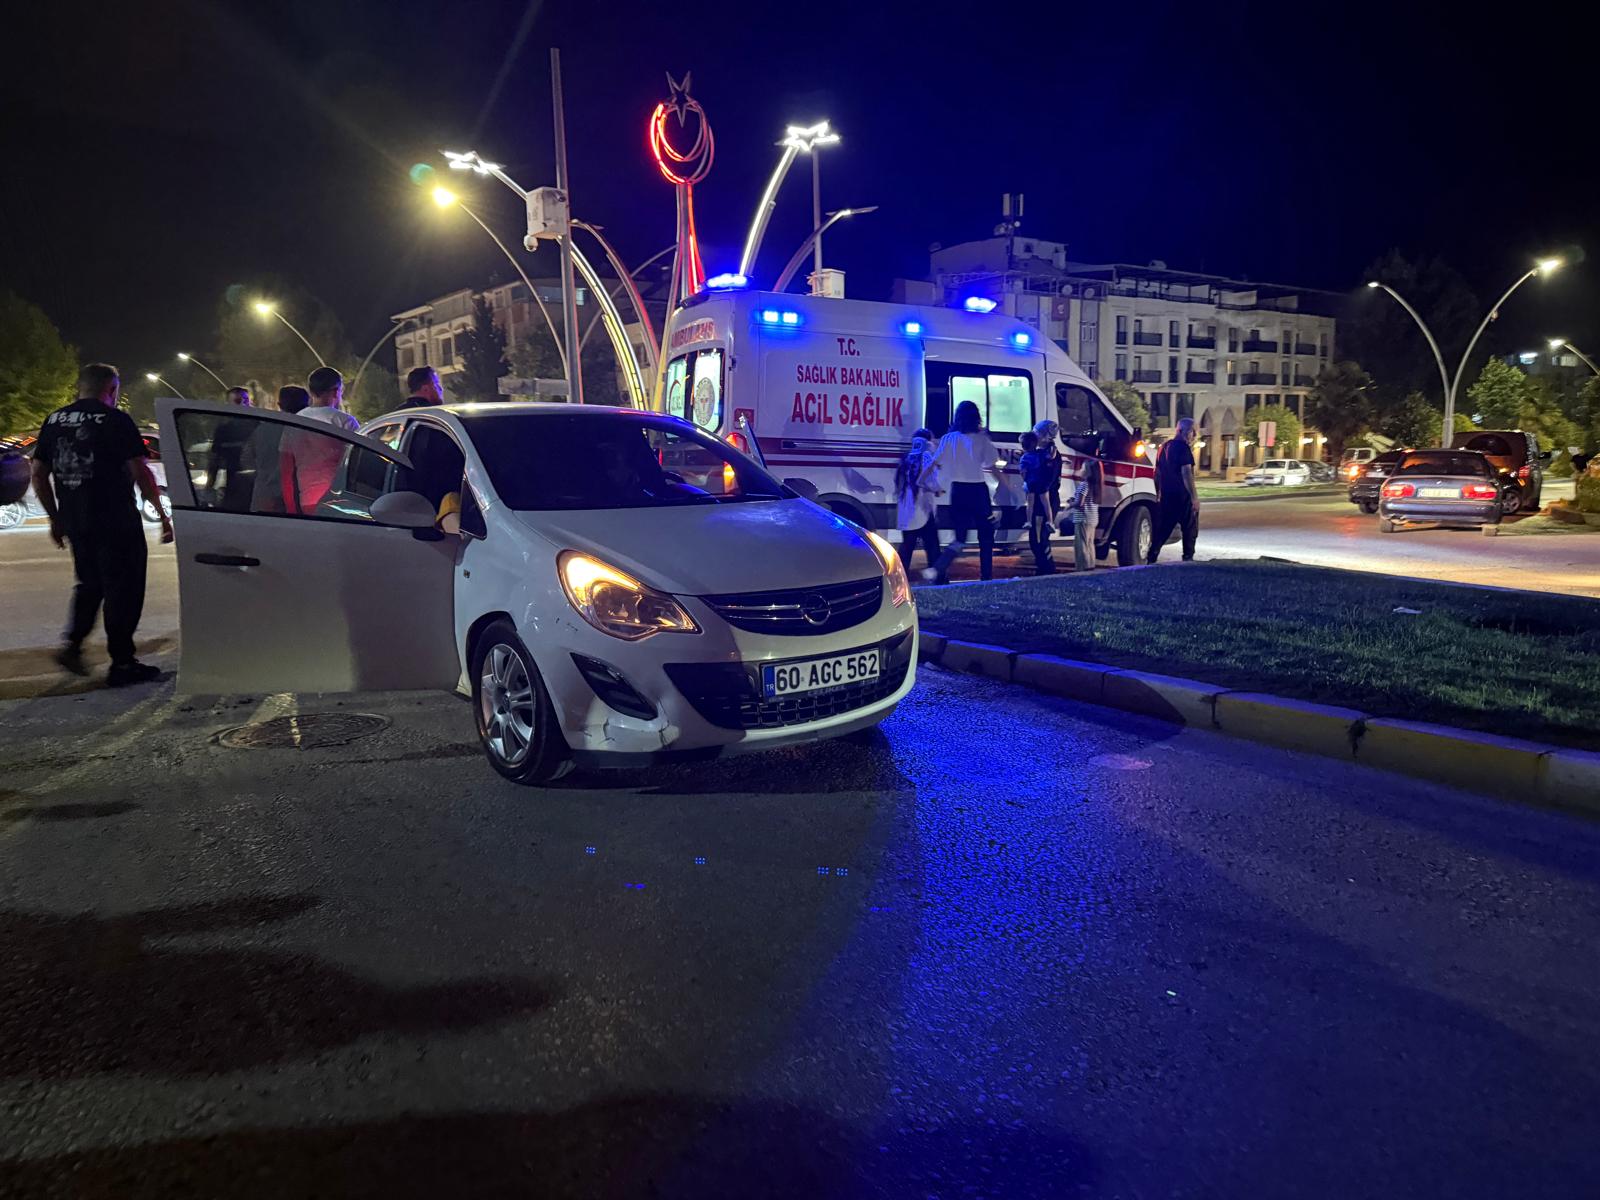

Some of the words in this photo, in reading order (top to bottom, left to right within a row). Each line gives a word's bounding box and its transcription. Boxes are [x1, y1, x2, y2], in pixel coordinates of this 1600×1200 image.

[837, 338, 860, 356] T.C.
[797, 363, 838, 385] SAĞLIK
[841, 367, 900, 388] BAKANLIĞI
[839, 392, 904, 427] SAĞLIK
[776, 667, 800, 692] 60
[808, 660, 842, 687] AGC
[847, 653, 878, 680] 562
